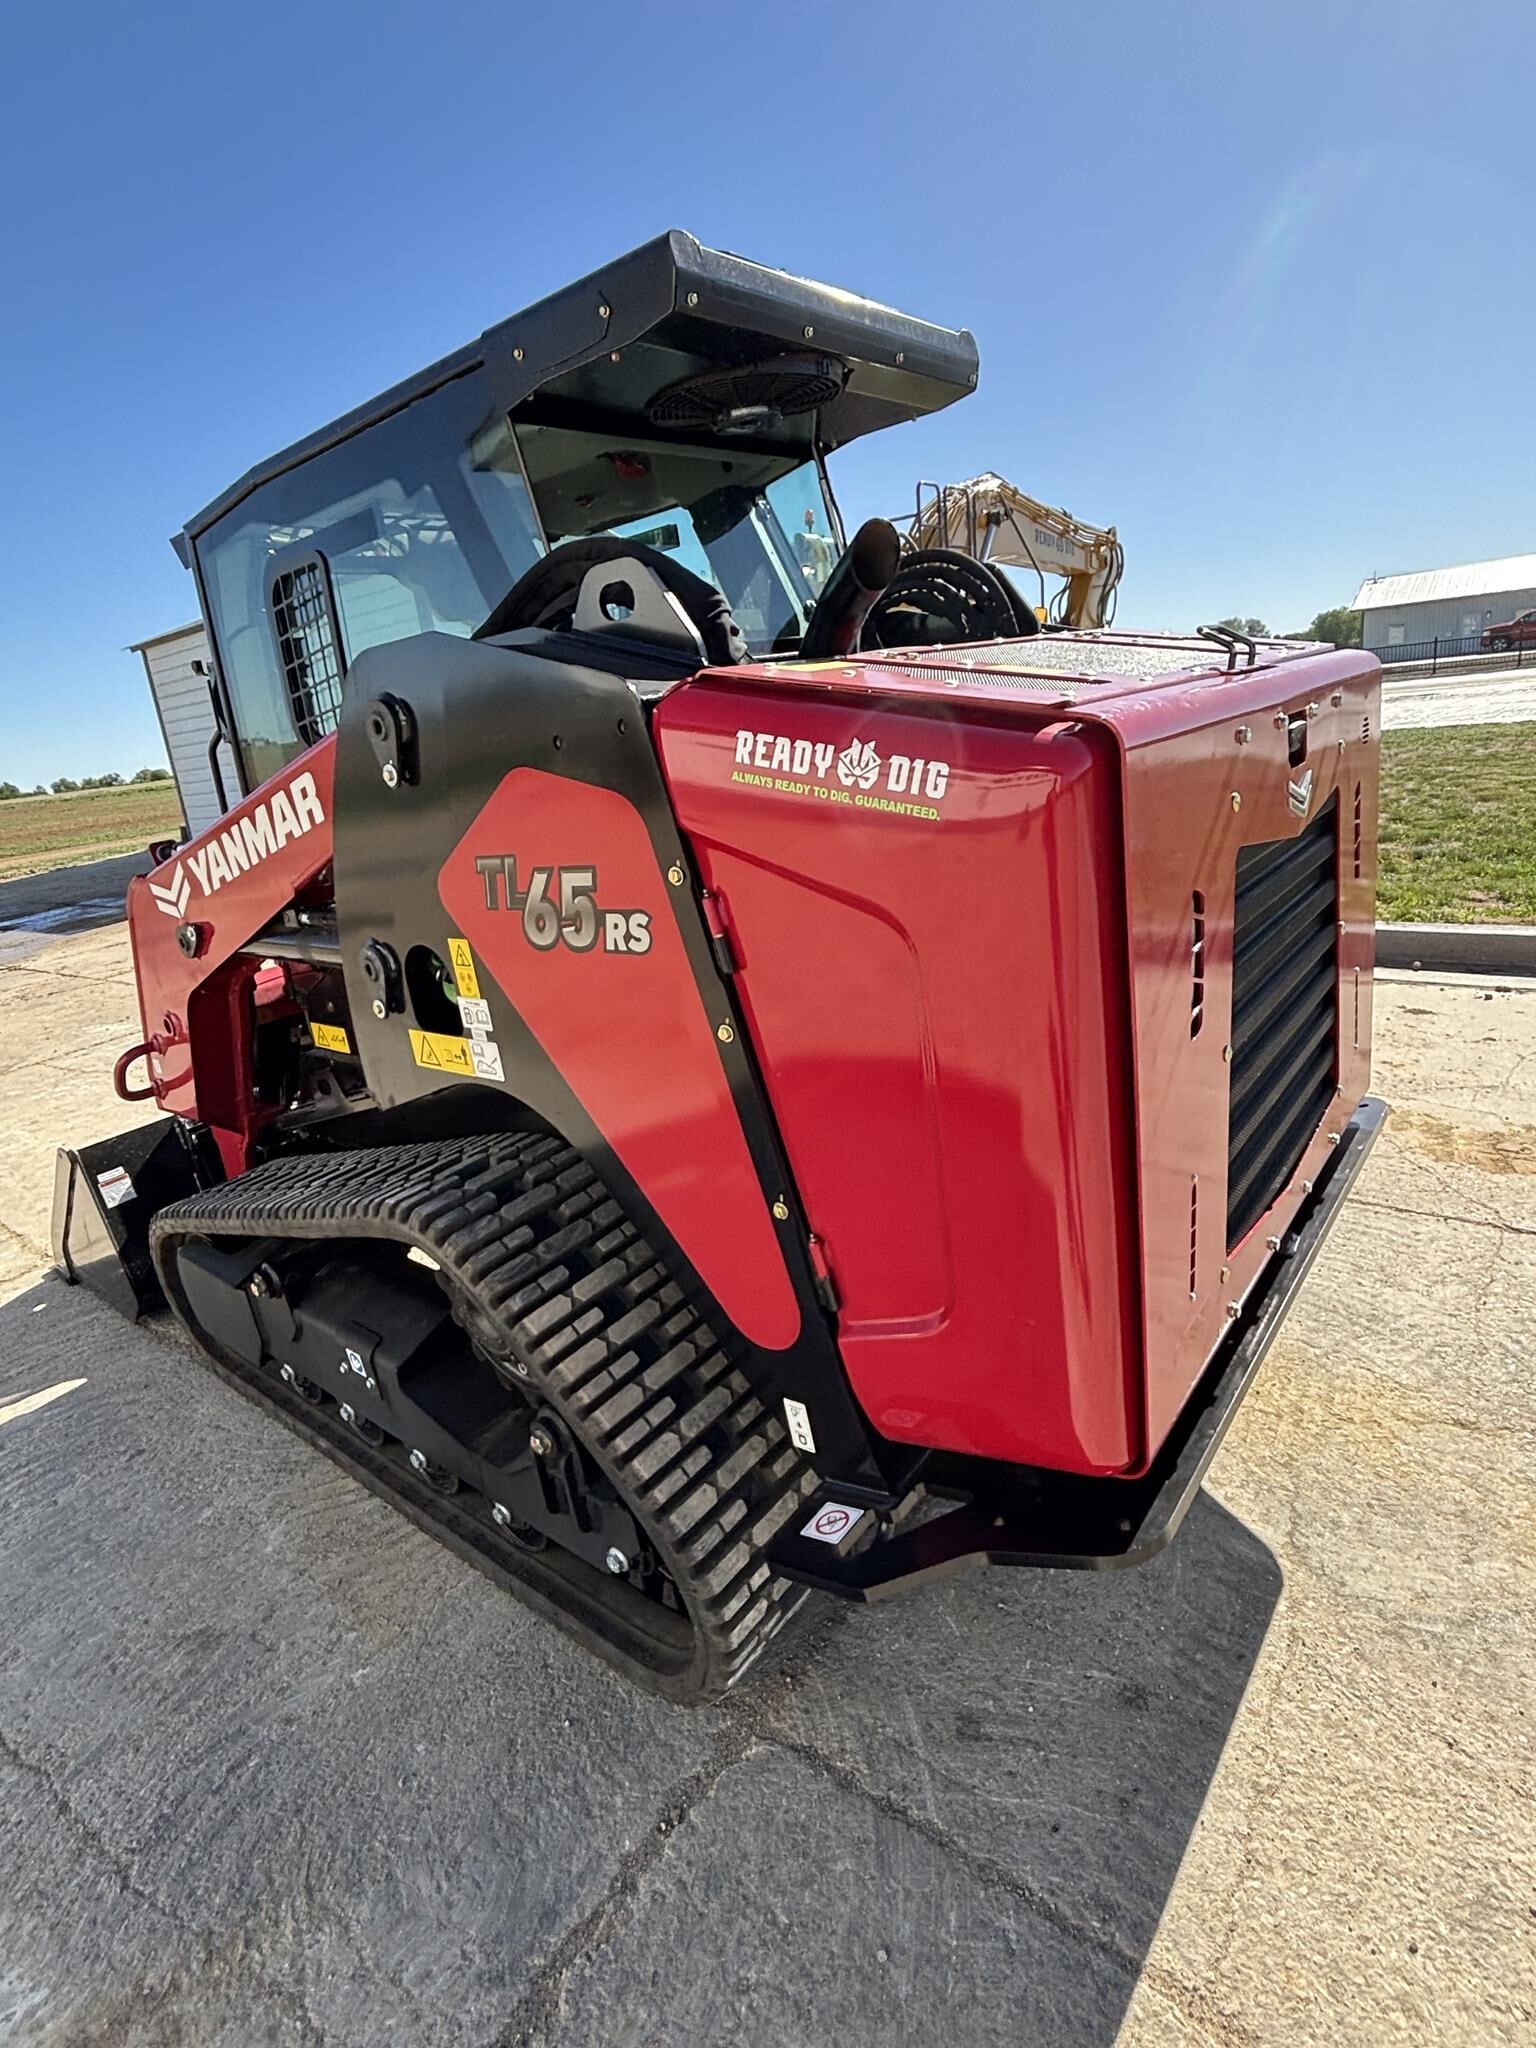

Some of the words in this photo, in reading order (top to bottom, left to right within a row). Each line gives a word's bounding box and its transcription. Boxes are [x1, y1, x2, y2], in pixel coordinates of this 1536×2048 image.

[731, 771, 773, 788] ALWAYS
[774, 779, 811, 795] READY
[813, 786, 828, 799] TO
[830, 789, 852, 804] DIG.
[855, 795, 941, 821] GUARANTEED.
[735, 730, 835, 778] READY
[886, 755, 950, 799] DIG
[186, 771, 325, 897] YANMAR
